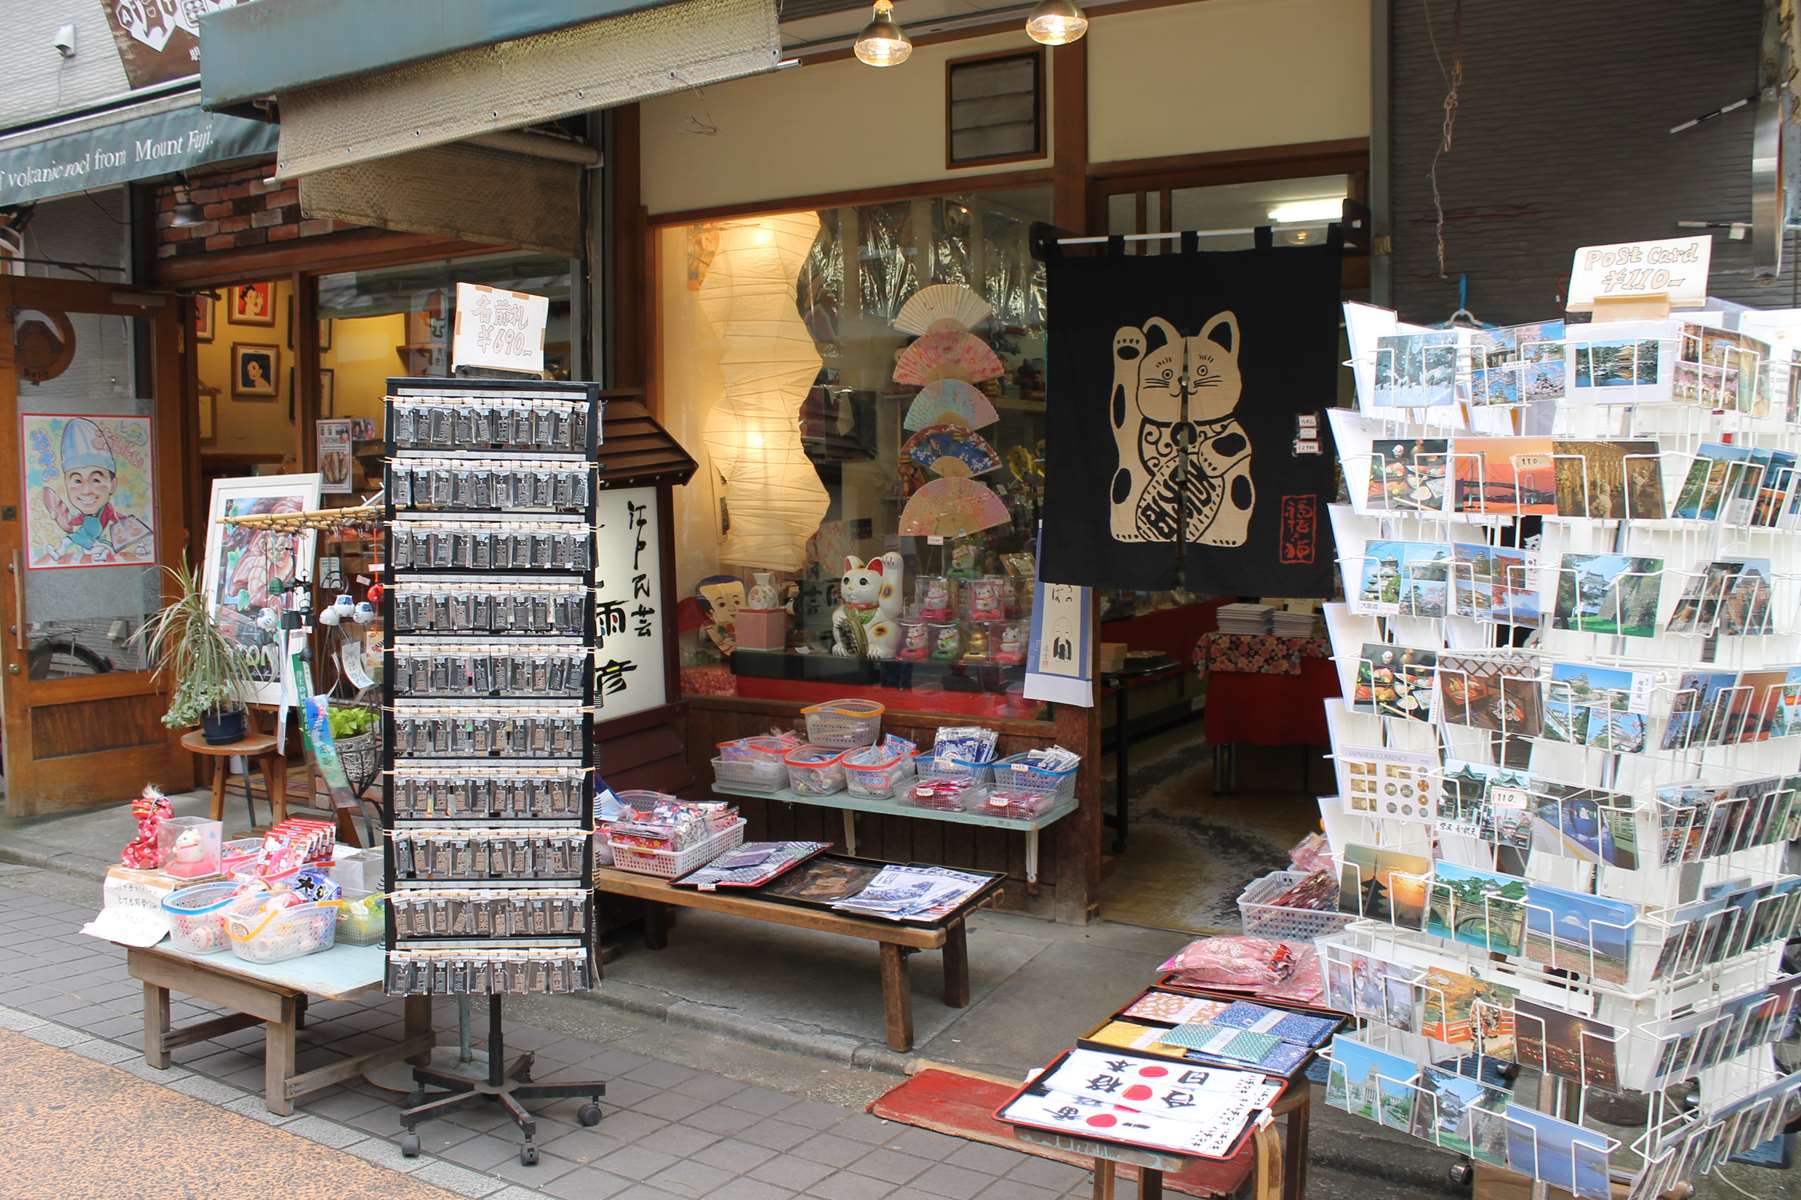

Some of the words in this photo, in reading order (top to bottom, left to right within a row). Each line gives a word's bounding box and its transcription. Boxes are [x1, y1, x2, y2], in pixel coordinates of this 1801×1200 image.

[135, 137, 184, 163] Mount
[1648, 242, 1699, 264] Card
[627, 500, 656, 638] 江戸民芸
